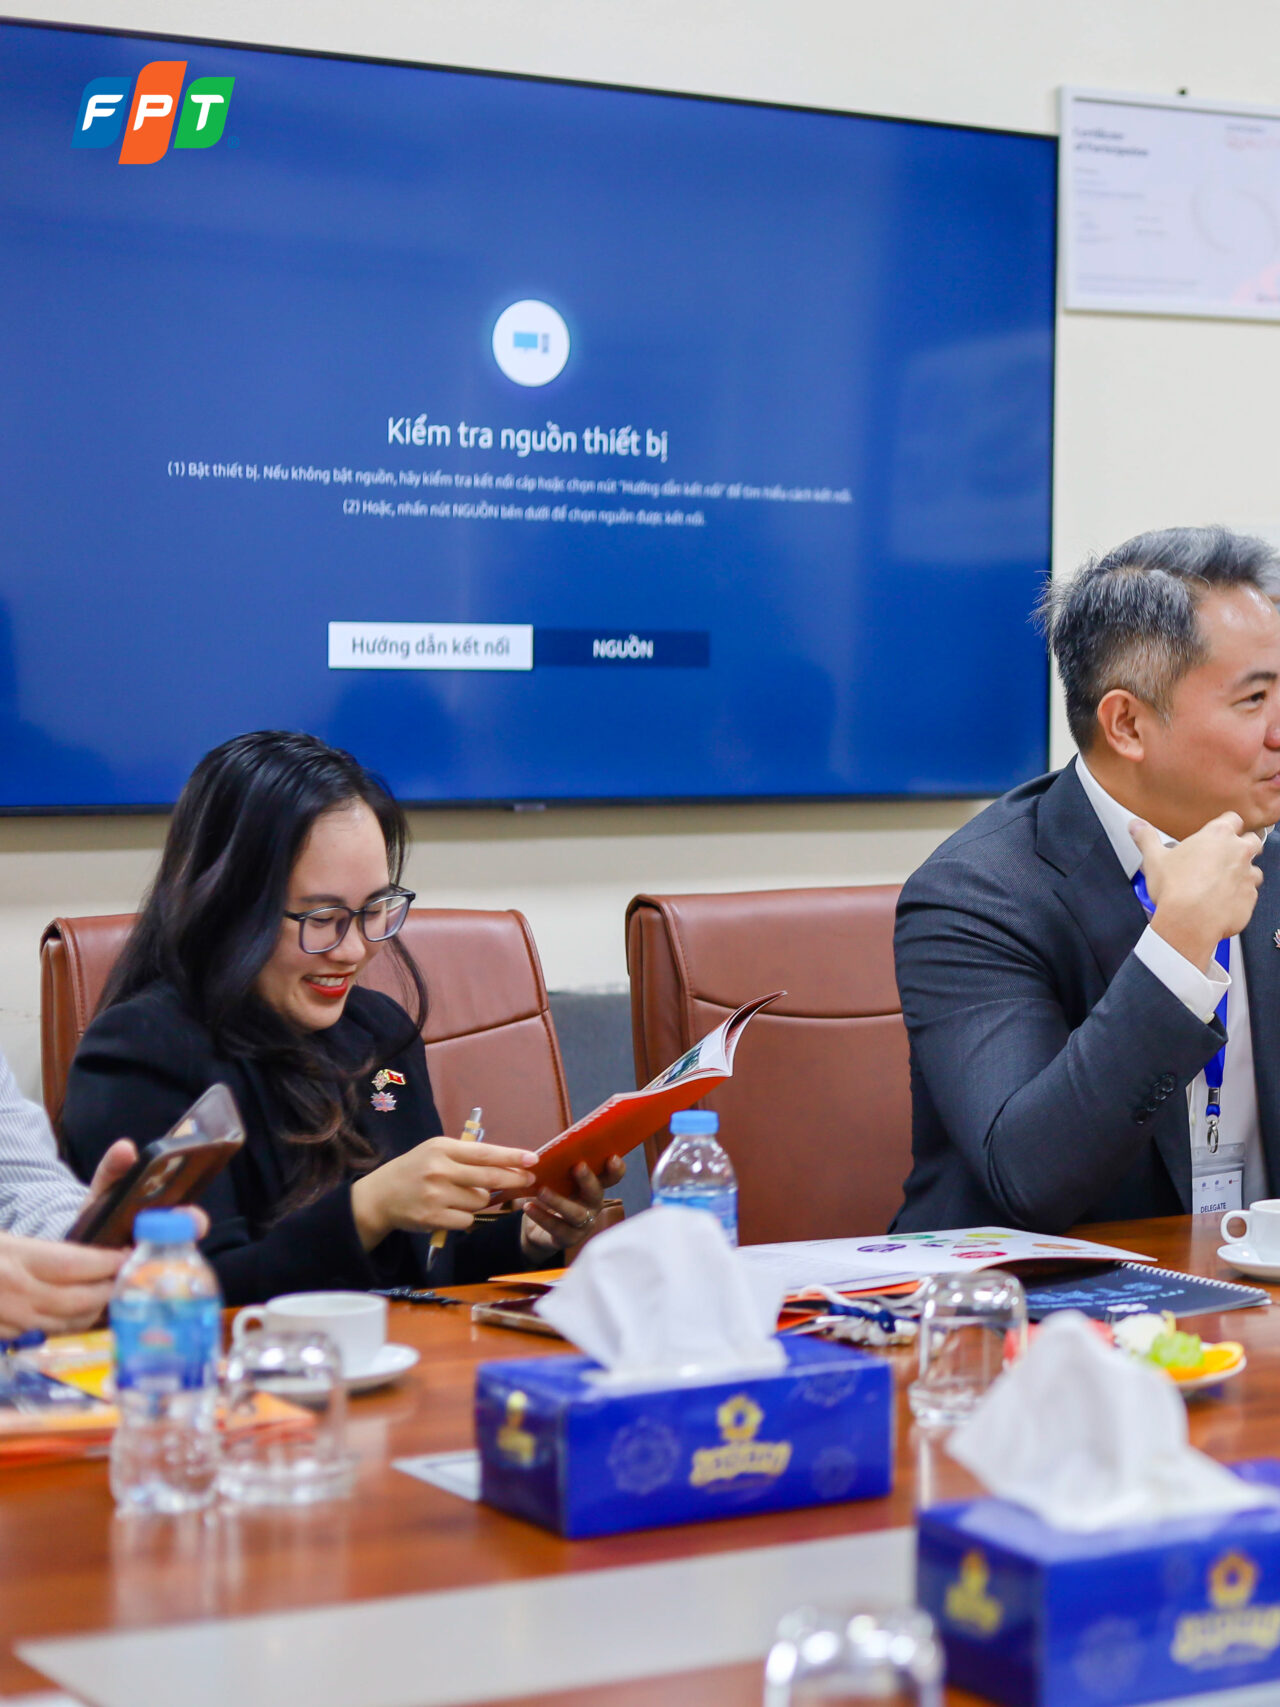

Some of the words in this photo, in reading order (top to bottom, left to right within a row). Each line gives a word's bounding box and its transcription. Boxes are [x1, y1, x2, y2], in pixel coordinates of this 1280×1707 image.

[387, 413, 450, 447] Kiểm
[457, 421, 493, 449] tra
[500, 420, 577, 458] nguồn
[582, 425, 641, 457] thiết
[645, 428, 668, 463] bị
[168, 461, 186, 477] (1)
[188, 461, 210, 480] Bật
[212, 461, 243, 479] thiết
[263, 463, 288, 480] Nếu
[291, 465, 331, 486] không
[454, 473, 472, 488] tra
[343, 498, 360, 516] (2)
[352, 635, 411, 660] Hướng
[415, 633, 448, 656] dẫn
[452, 635, 480, 656] kết
[483, 634, 511, 656] nối
[592, 633, 654, 659] NGUỒN
[1200, 1202, 1227, 1214] DELEGATE
